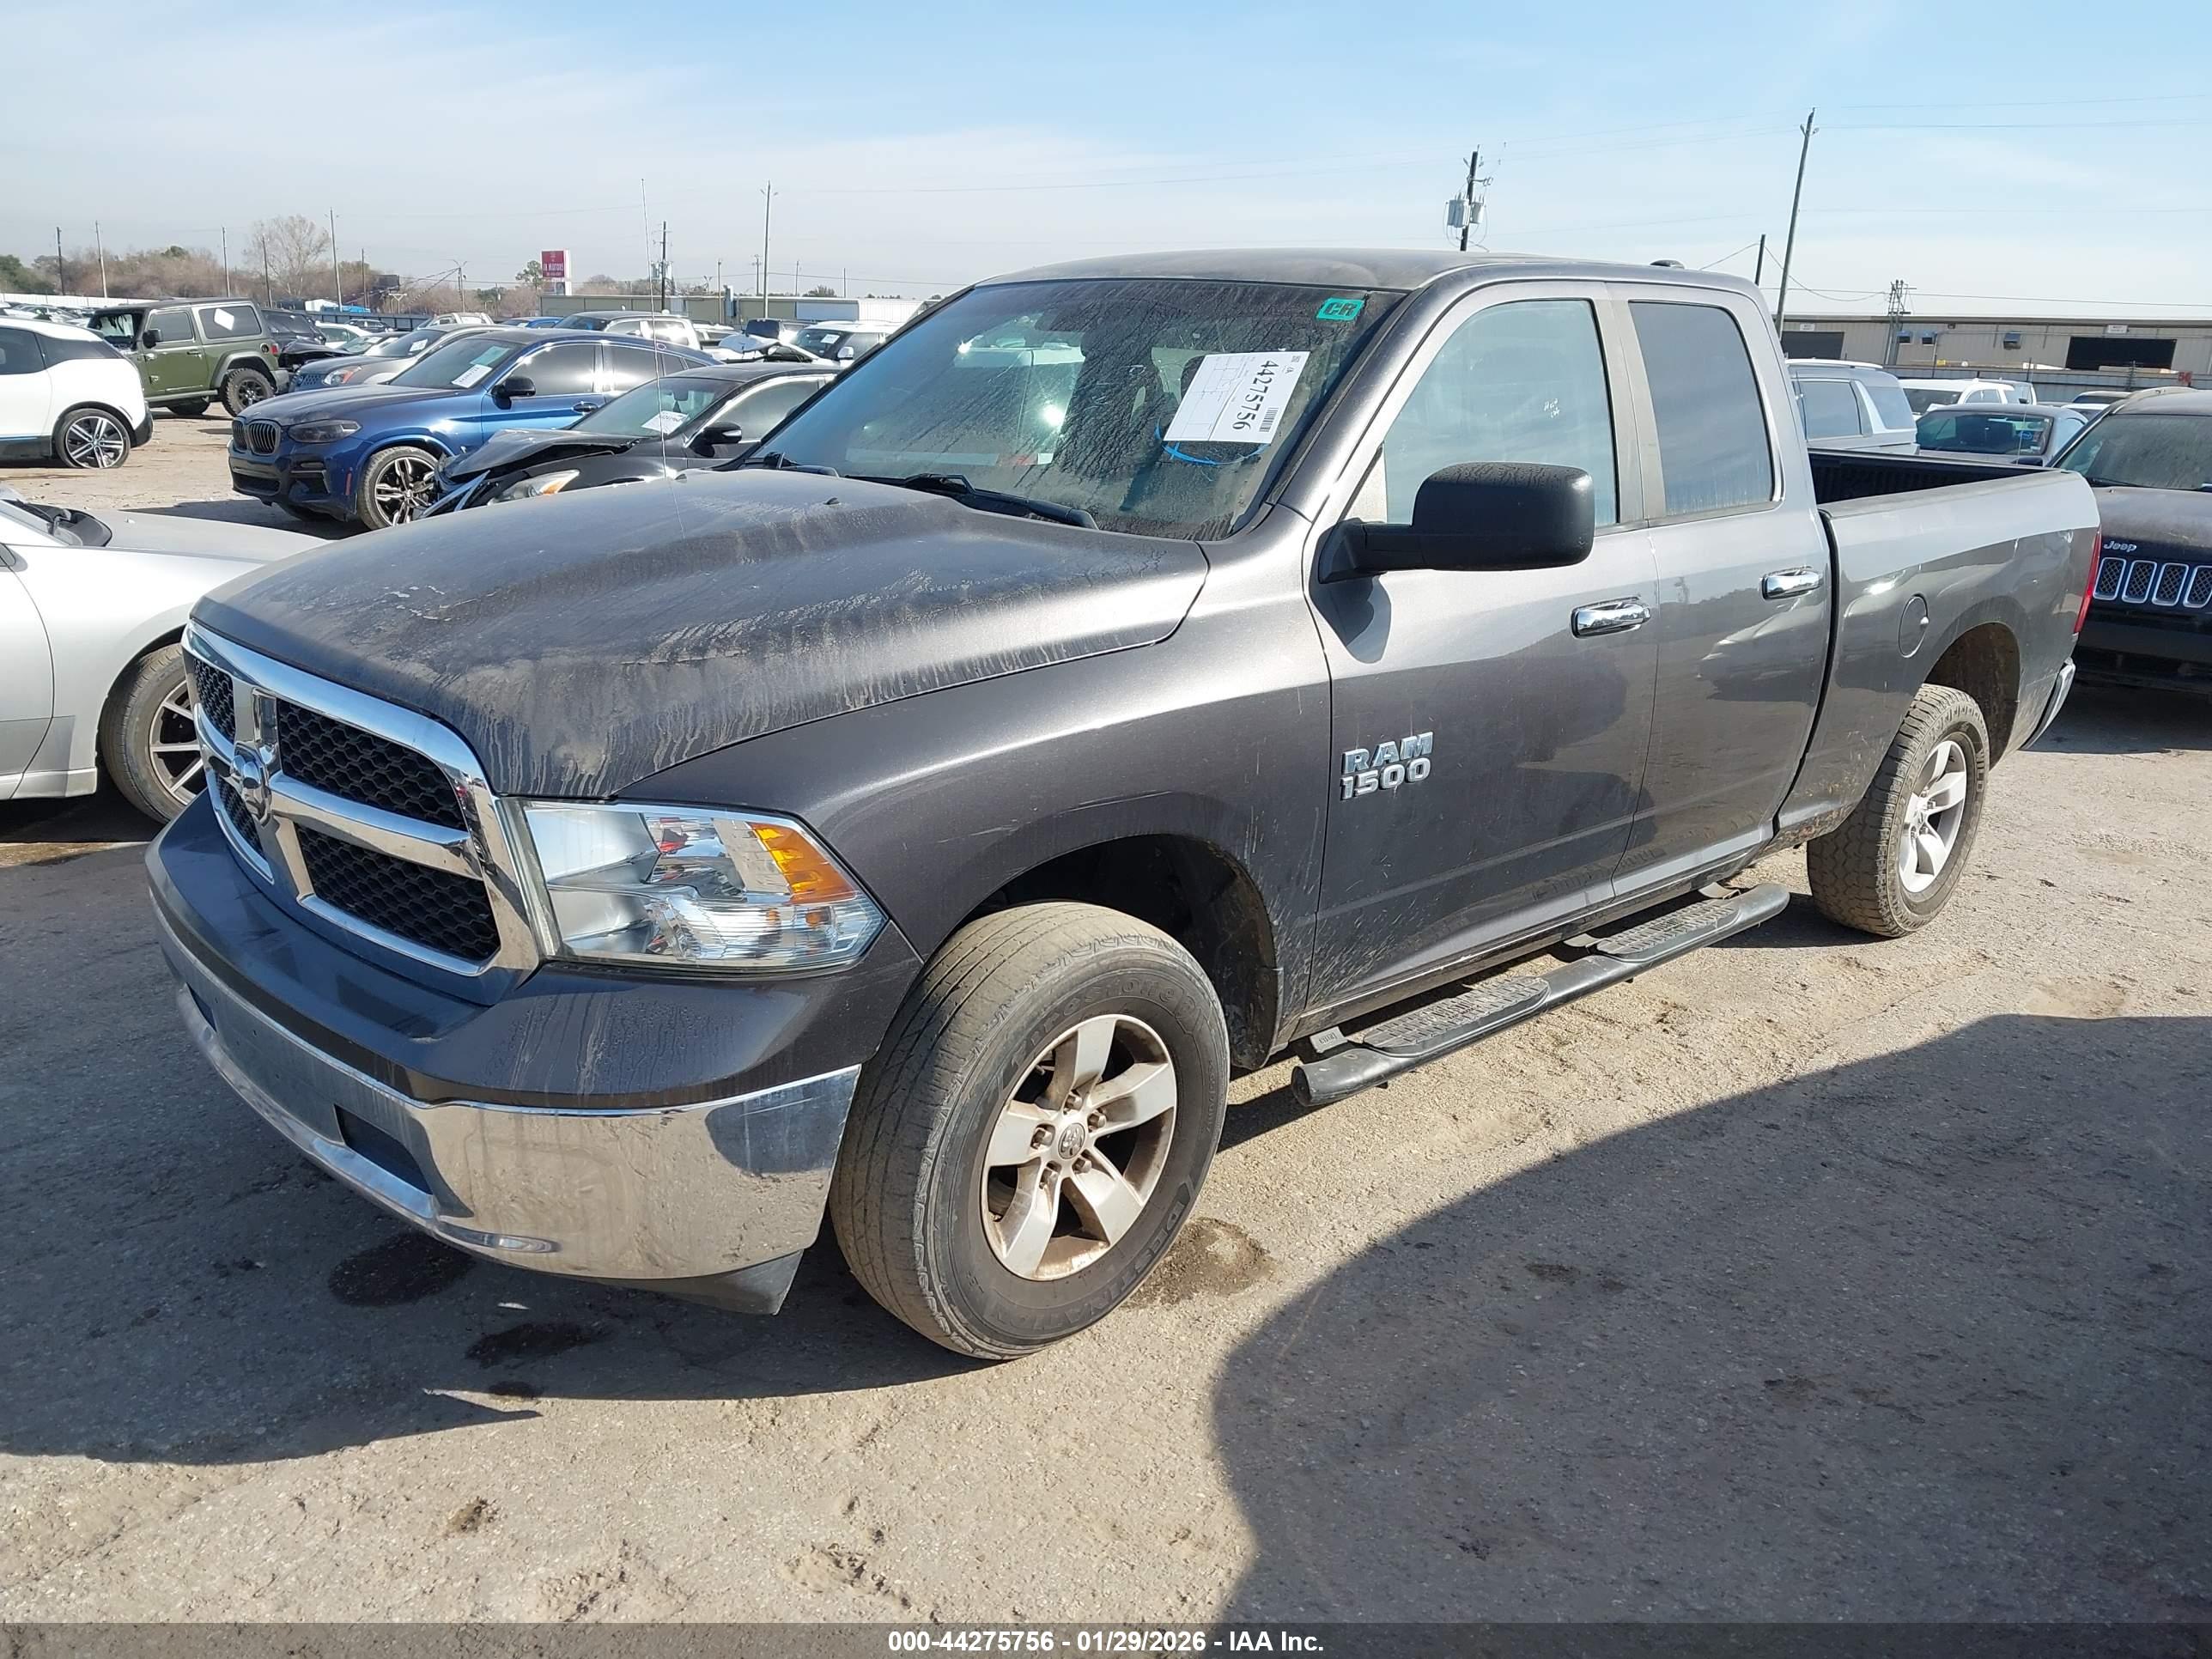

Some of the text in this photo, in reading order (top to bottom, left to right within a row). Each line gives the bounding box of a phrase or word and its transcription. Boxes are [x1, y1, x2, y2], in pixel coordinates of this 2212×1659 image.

[1324, 301, 1358, 317] CR
[1232, 359, 1279, 431] 44275756
[2103, 540, 2137, 552] Jeep
[1342, 732, 1433, 775] RAM
[1340, 757, 1431, 799] 1500
[1009, 977, 1176, 1072] Firestone
[995, 1200, 1186, 1331] DESTINATION
